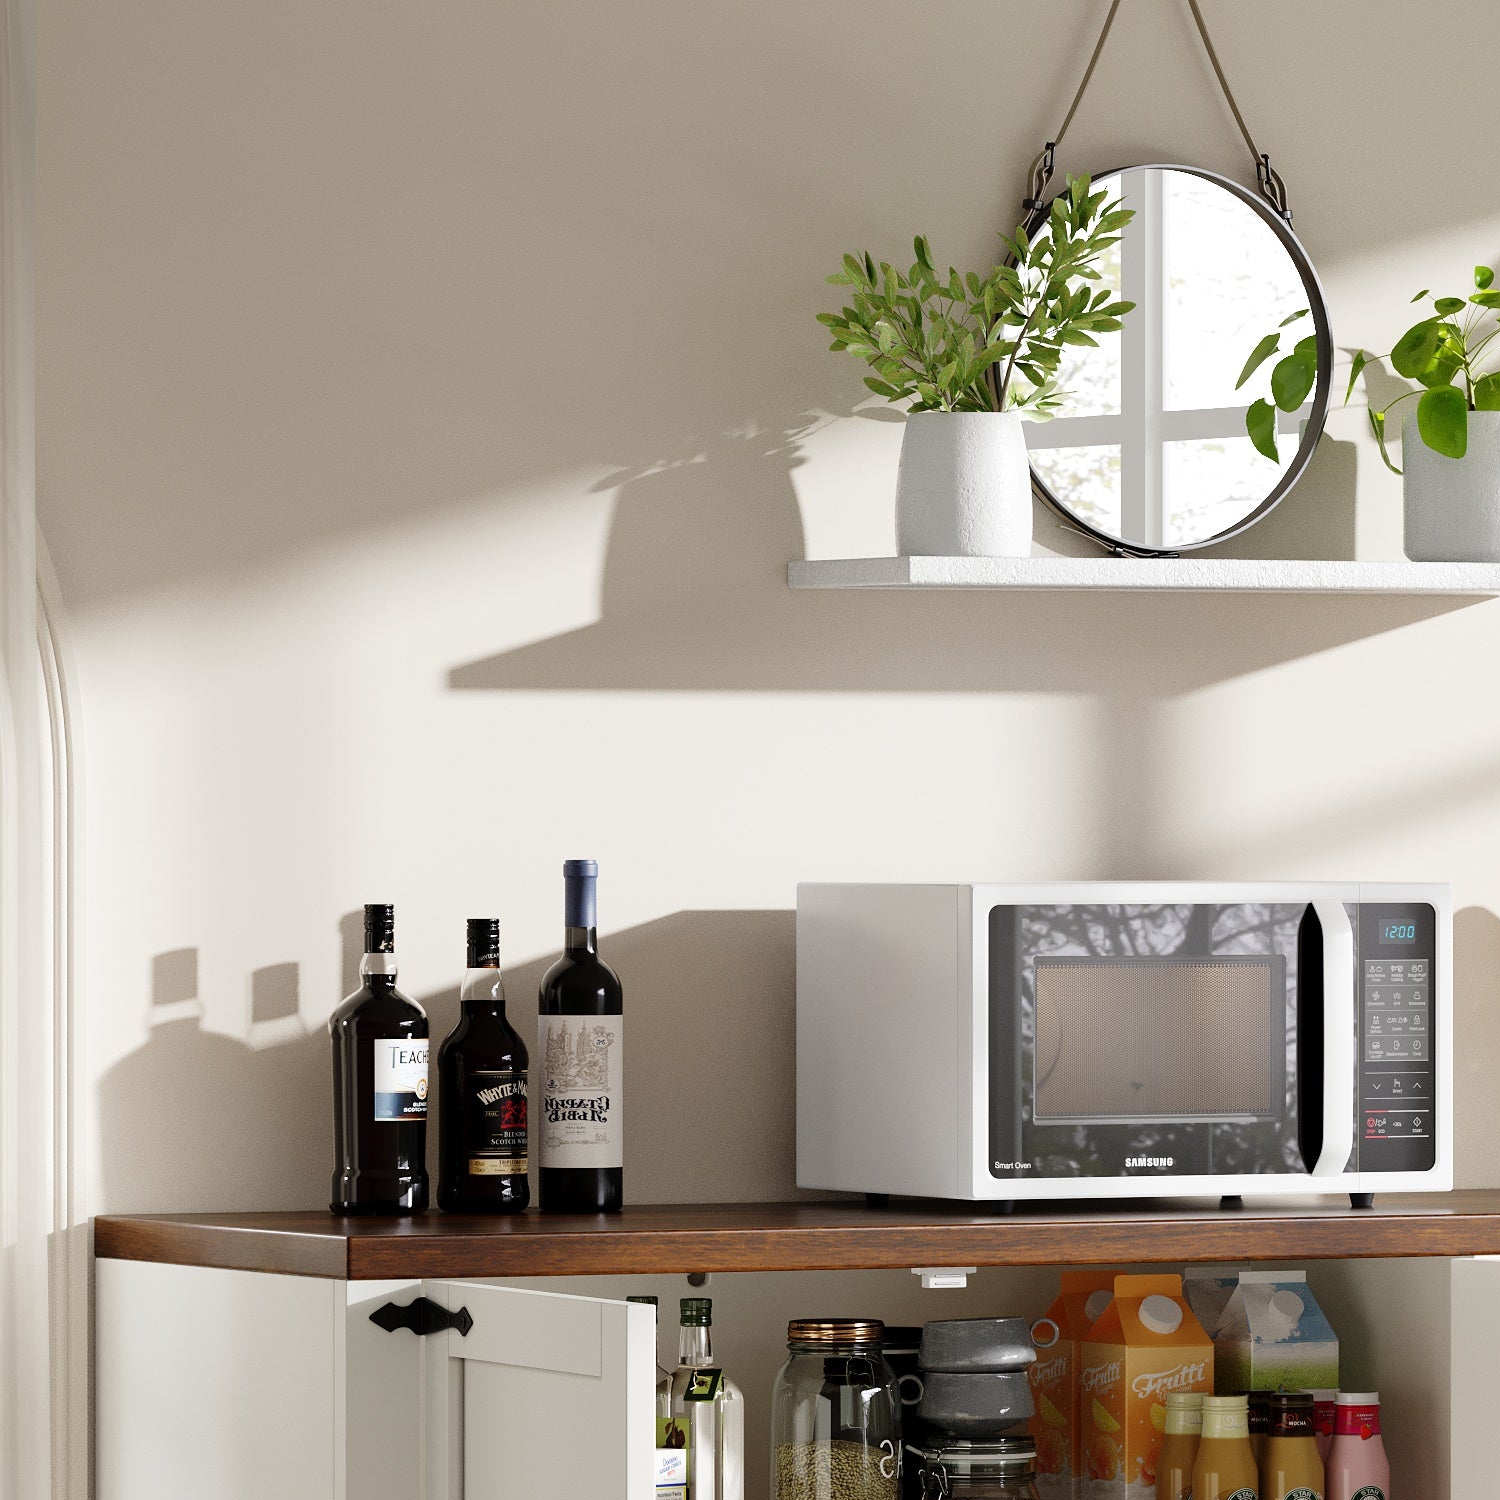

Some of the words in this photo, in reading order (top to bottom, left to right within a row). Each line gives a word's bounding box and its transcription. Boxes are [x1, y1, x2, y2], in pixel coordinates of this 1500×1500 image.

[1385, 925, 1415, 938] 12:00
[388, 1046, 429, 1068] TEACH
[476, 1083, 514, 1106] WHYTE
[994, 1161, 1014, 1170] Smart
[1014, 1162, 1032, 1170] Oven
[1124, 1157, 1174, 1168] SAMSUNG
[1082, 1360, 1120, 1392] Frutti
[1132, 1362, 1206, 1399] Frutti
[1237, 1491, 1254, 1499] STAR
[1292, 1490, 1312, 1498] STAR
[1360, 1488, 1380, 1496] STAR
